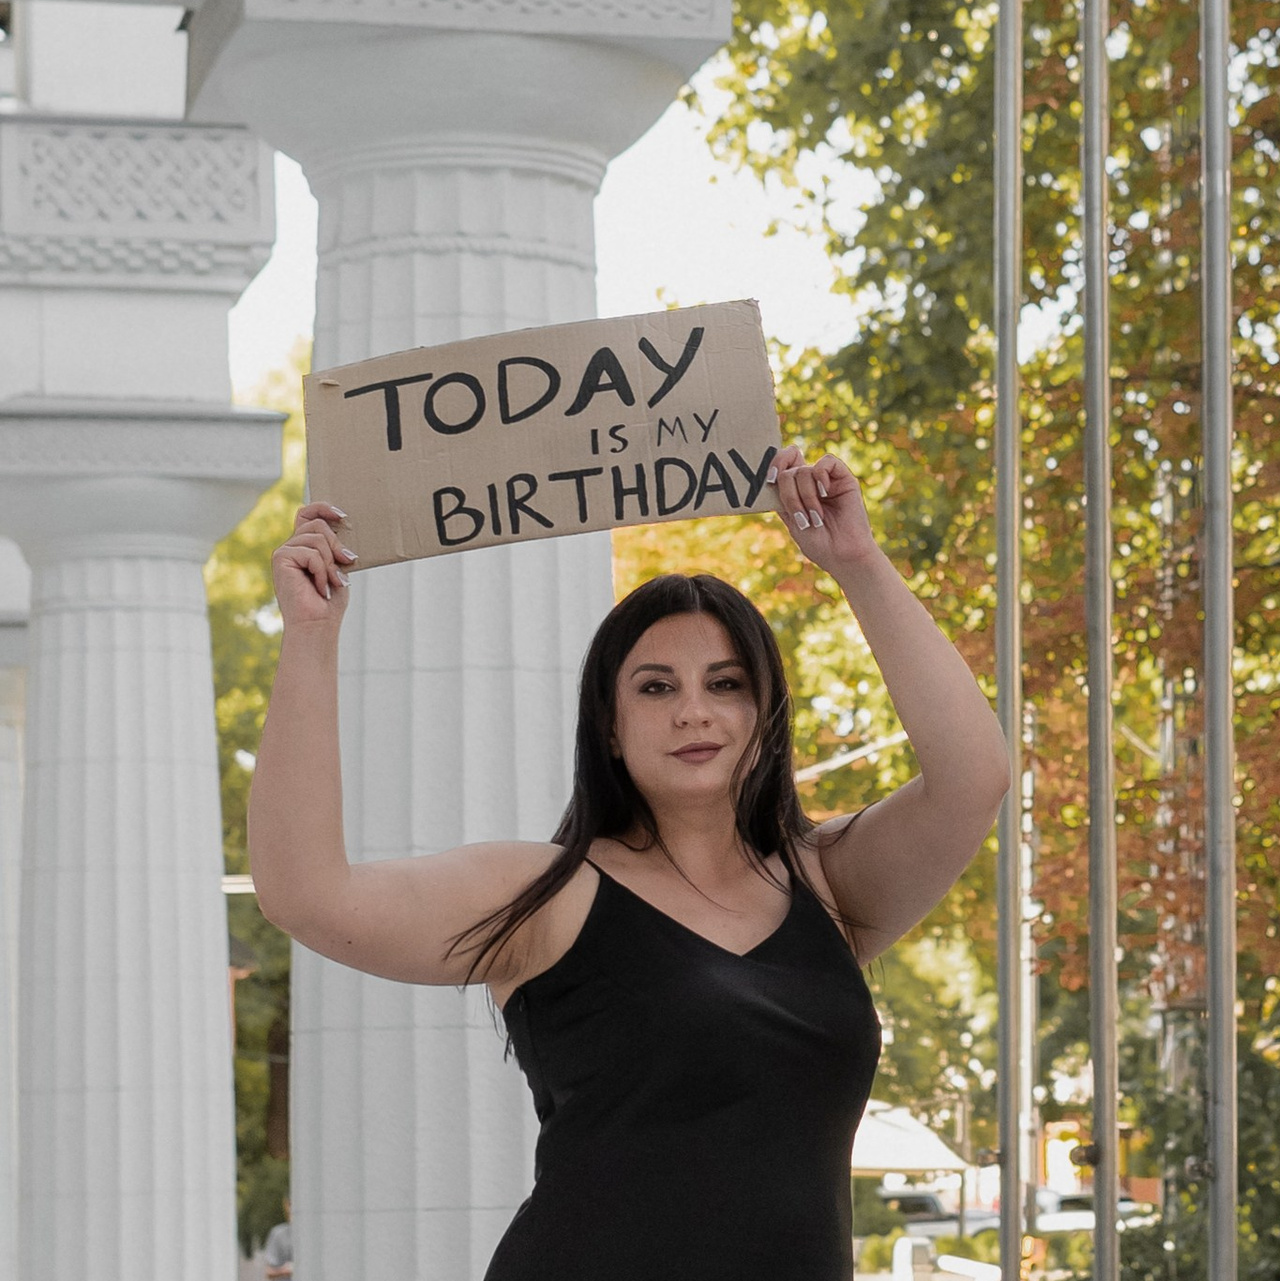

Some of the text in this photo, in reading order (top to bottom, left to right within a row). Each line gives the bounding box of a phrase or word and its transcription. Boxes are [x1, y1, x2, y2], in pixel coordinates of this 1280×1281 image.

[343, 326, 705, 452] TODAY
[590, 408, 720, 456] IS MY
[432, 446, 778, 547] BIRTHDAY
